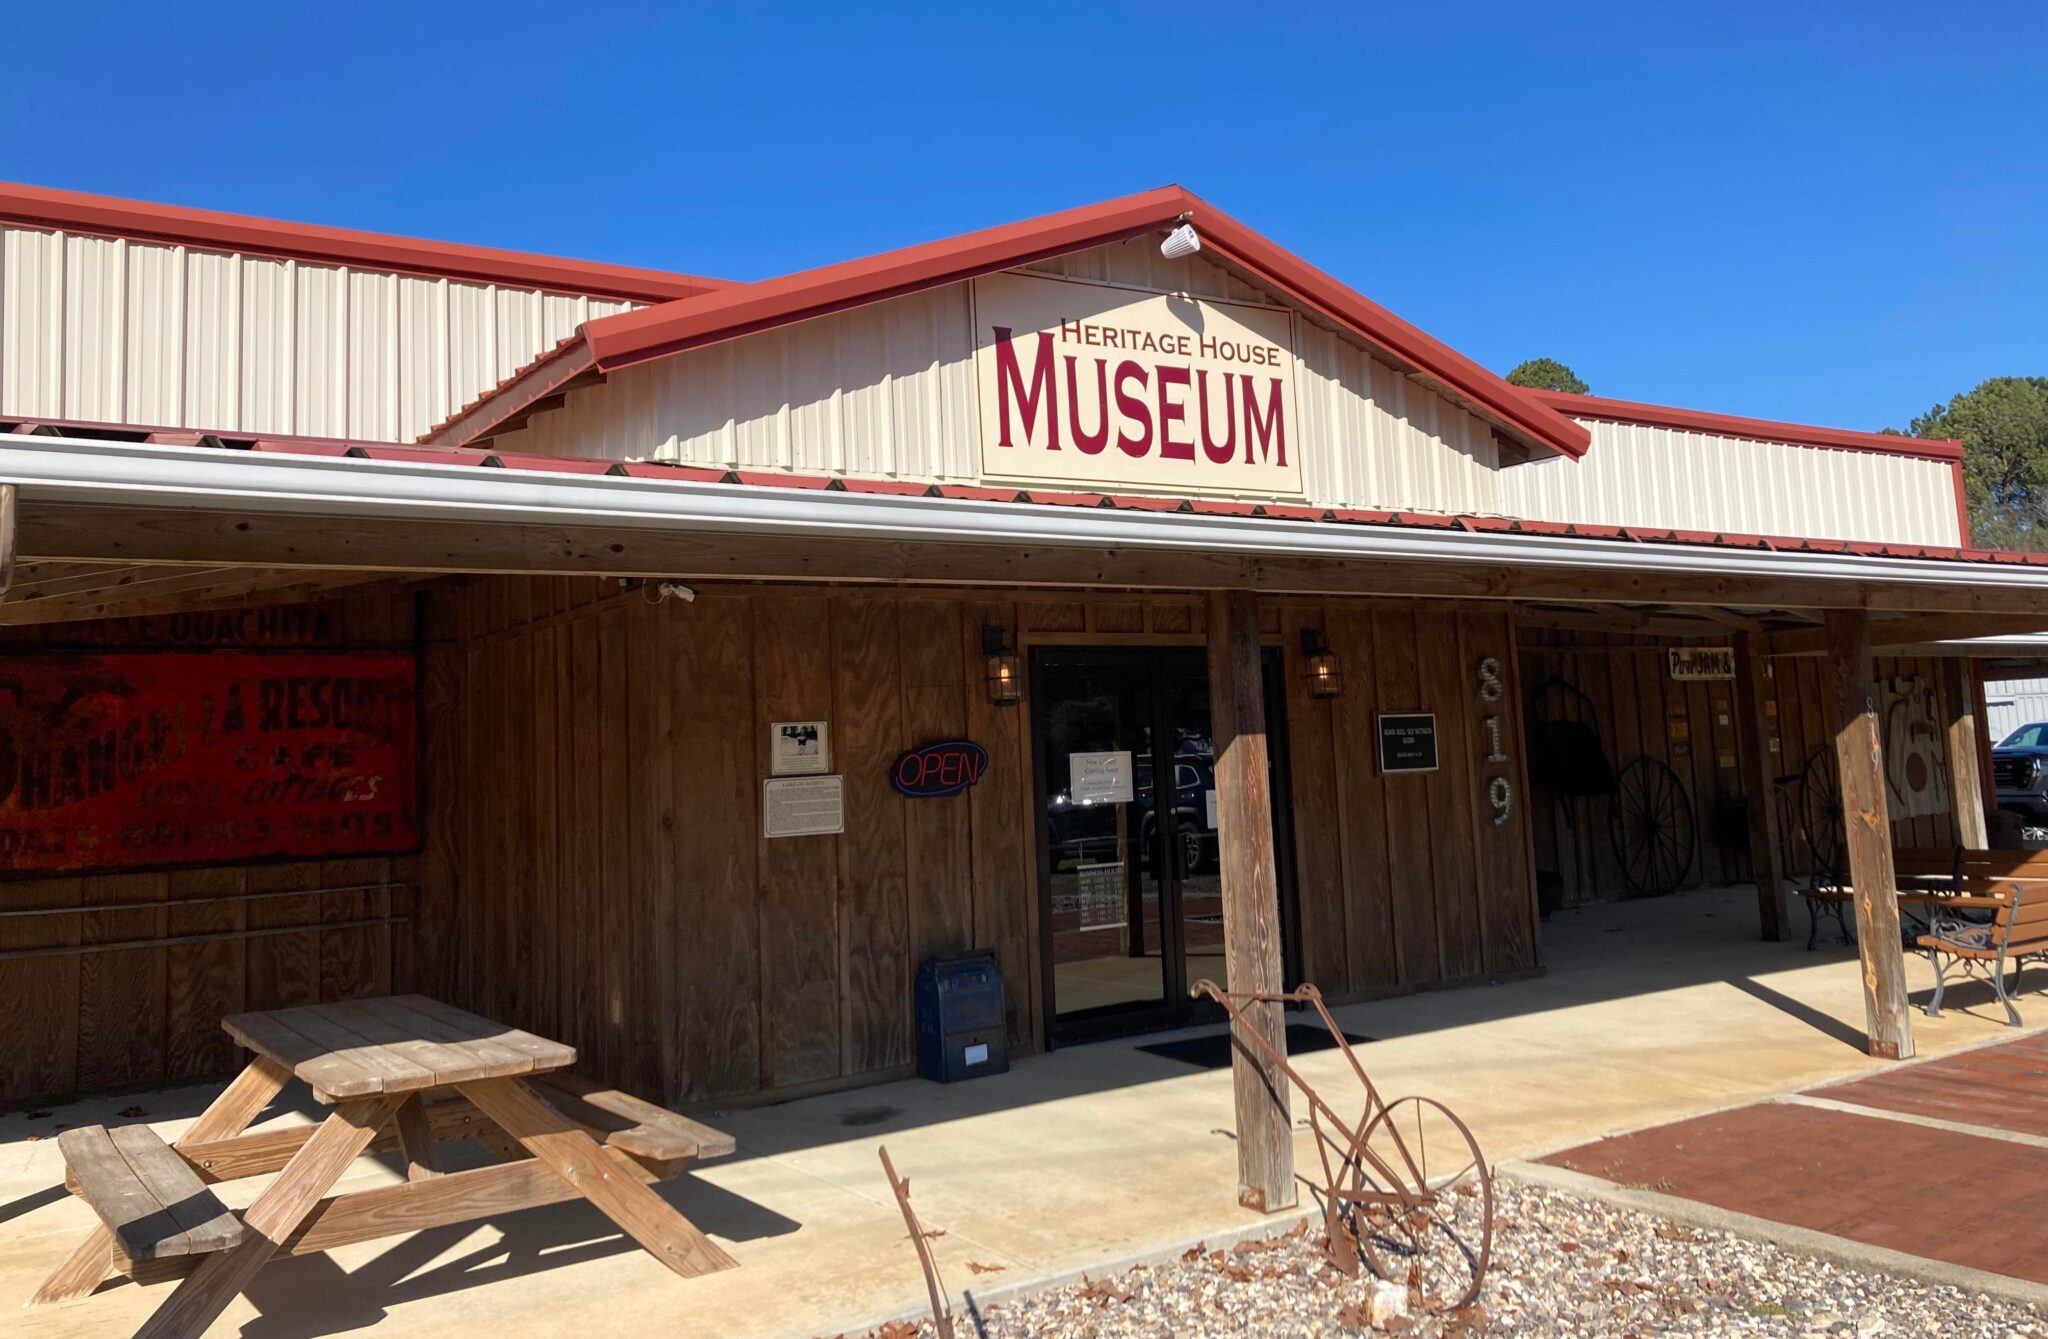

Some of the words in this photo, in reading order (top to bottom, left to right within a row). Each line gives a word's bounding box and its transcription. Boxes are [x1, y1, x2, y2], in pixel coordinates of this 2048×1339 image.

[1061, 318, 1191, 356] HERITAGE
[1200, 335, 1281, 366] HOUSE
[992, 326, 1288, 467] MUSEUM
[1697, 650, 1720, 674] JAM
[898, 752, 979, 786] OPEN
